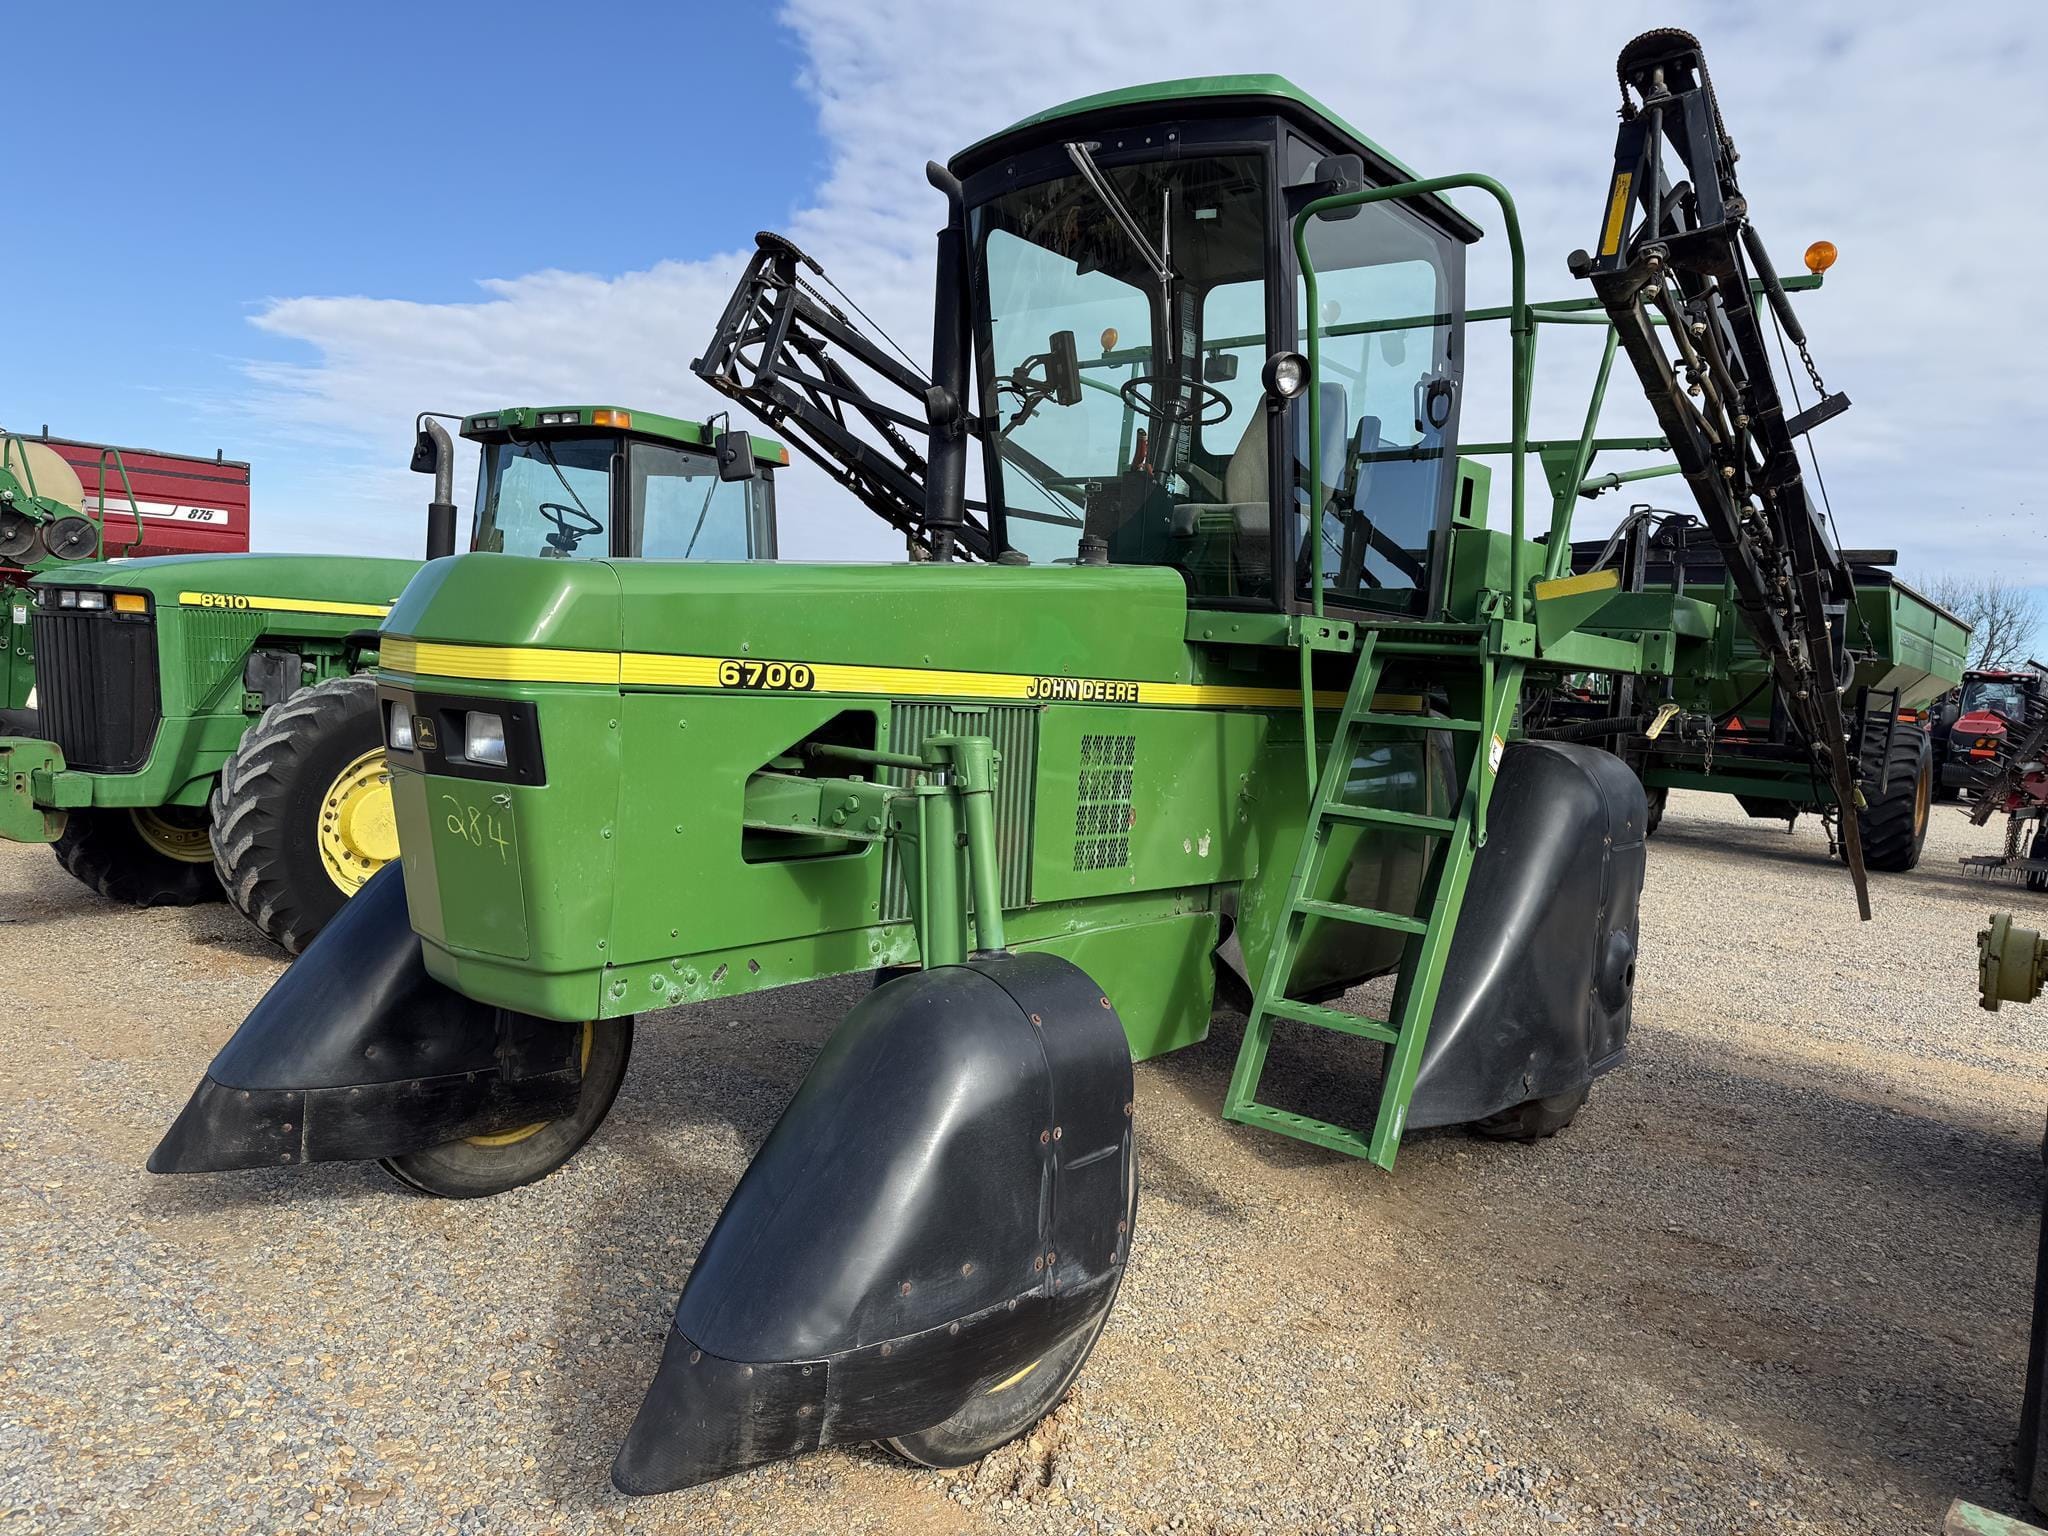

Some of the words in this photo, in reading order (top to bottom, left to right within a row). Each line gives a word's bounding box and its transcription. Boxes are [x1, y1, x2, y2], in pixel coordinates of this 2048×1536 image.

[188, 508, 215, 521] 875
[201, 593, 249, 609] 8410
[719, 660, 815, 690] 6700
[1026, 678, 1079, 700] JOHN
[1083, 681, 1138, 703] DEERE
[442, 794, 510, 866] 284
